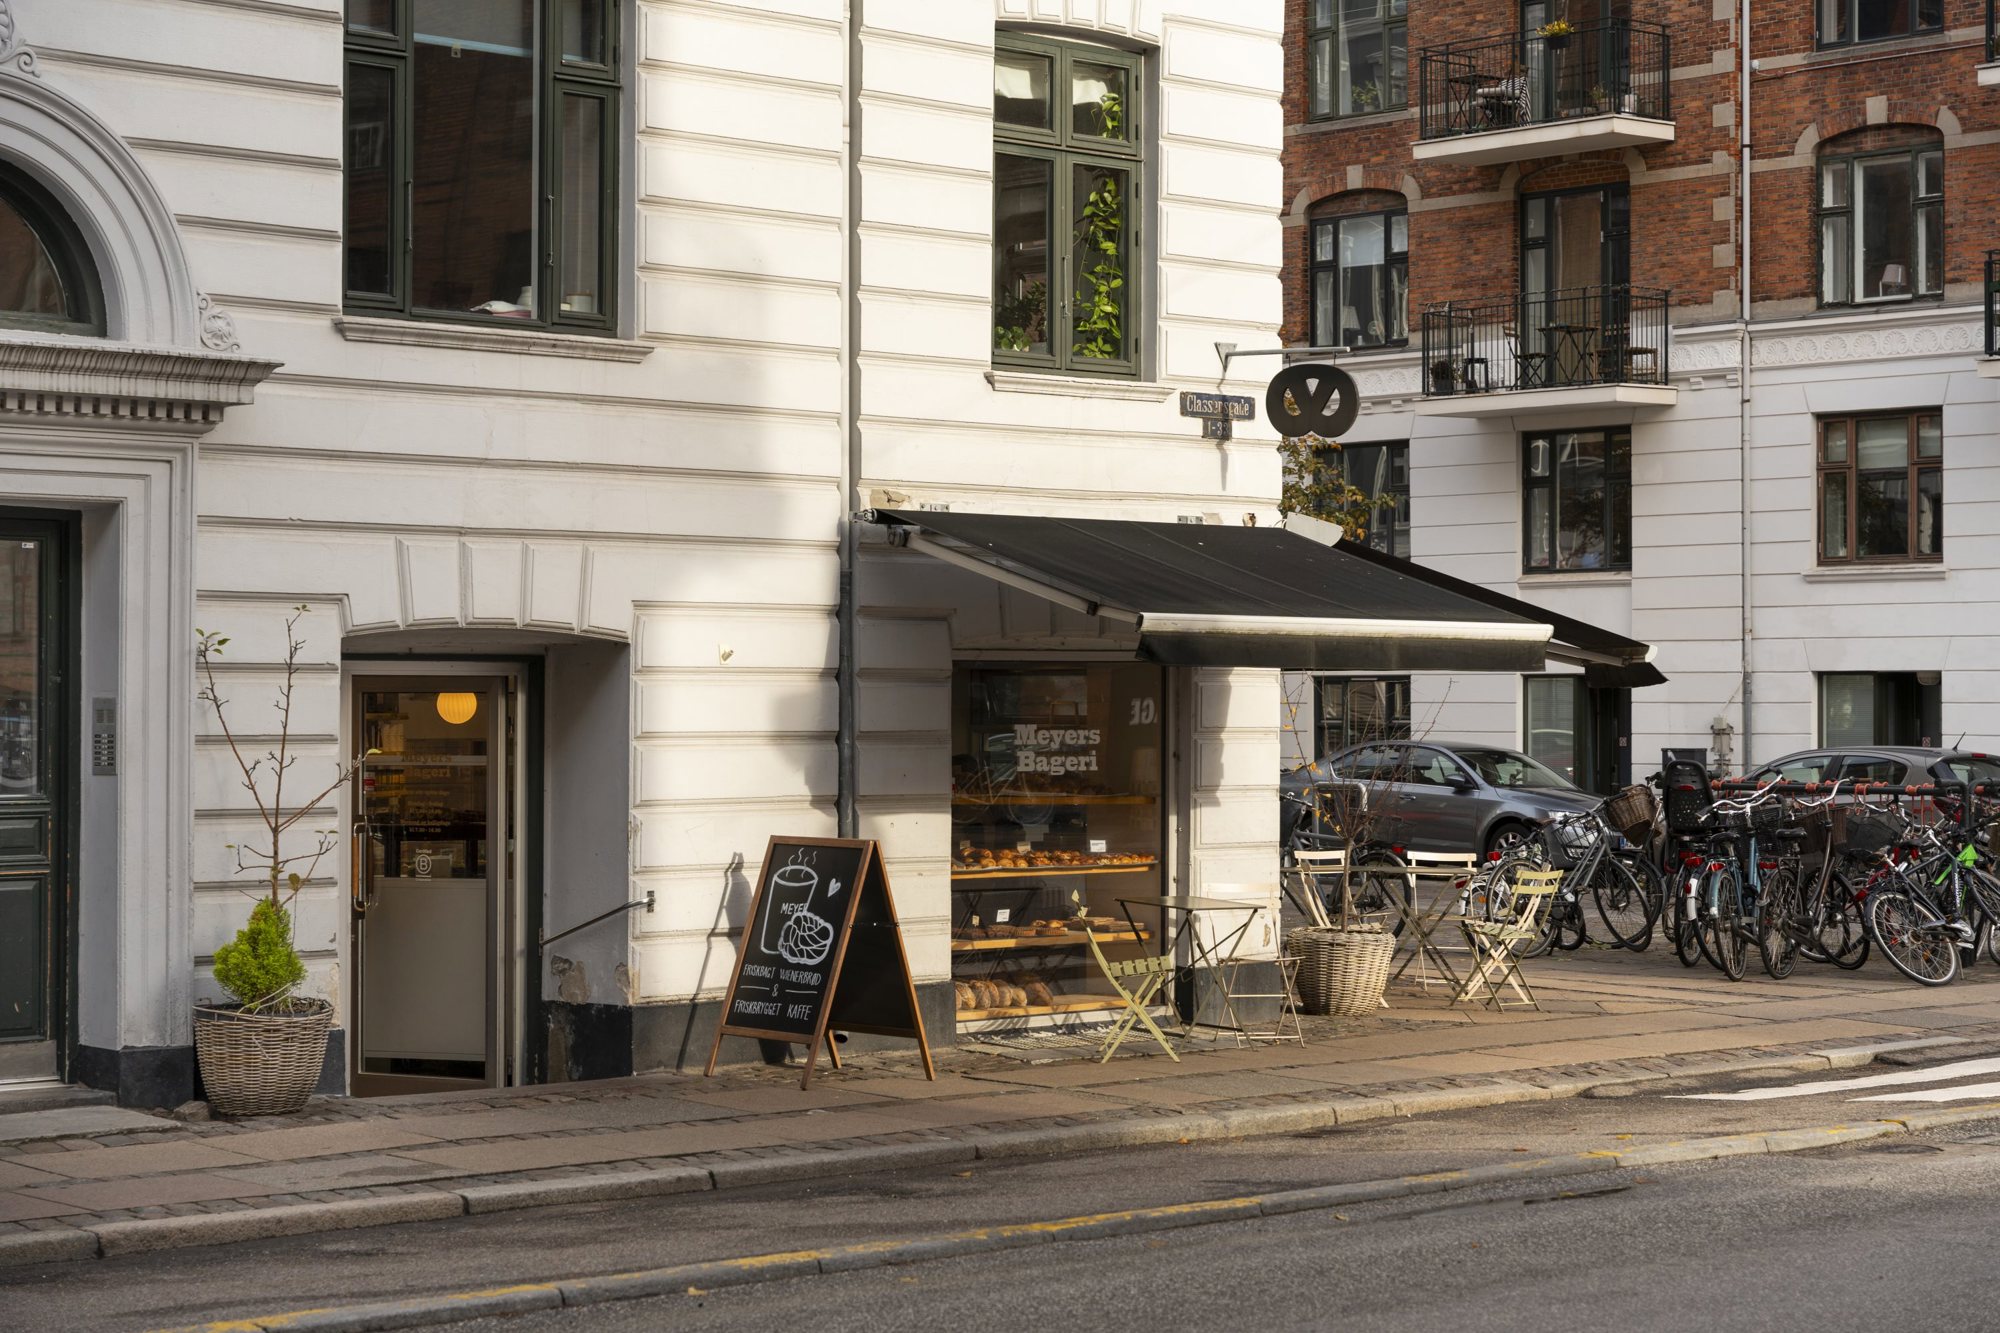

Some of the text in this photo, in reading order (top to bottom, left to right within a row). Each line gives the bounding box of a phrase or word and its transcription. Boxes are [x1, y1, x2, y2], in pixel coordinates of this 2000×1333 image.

[1186, 394, 1249, 417] Classensgade
[1014, 724, 1101, 749] Meyers
[404, 766, 451, 780] ageri
[1016, 750, 1098, 776] Bageri
[742, 964, 822, 986] FRISKBAGT WIENERBRØD
[771, 983, 779, 997] &
[734, 999, 813, 1021] FRISKBRYGGET KAFFE
